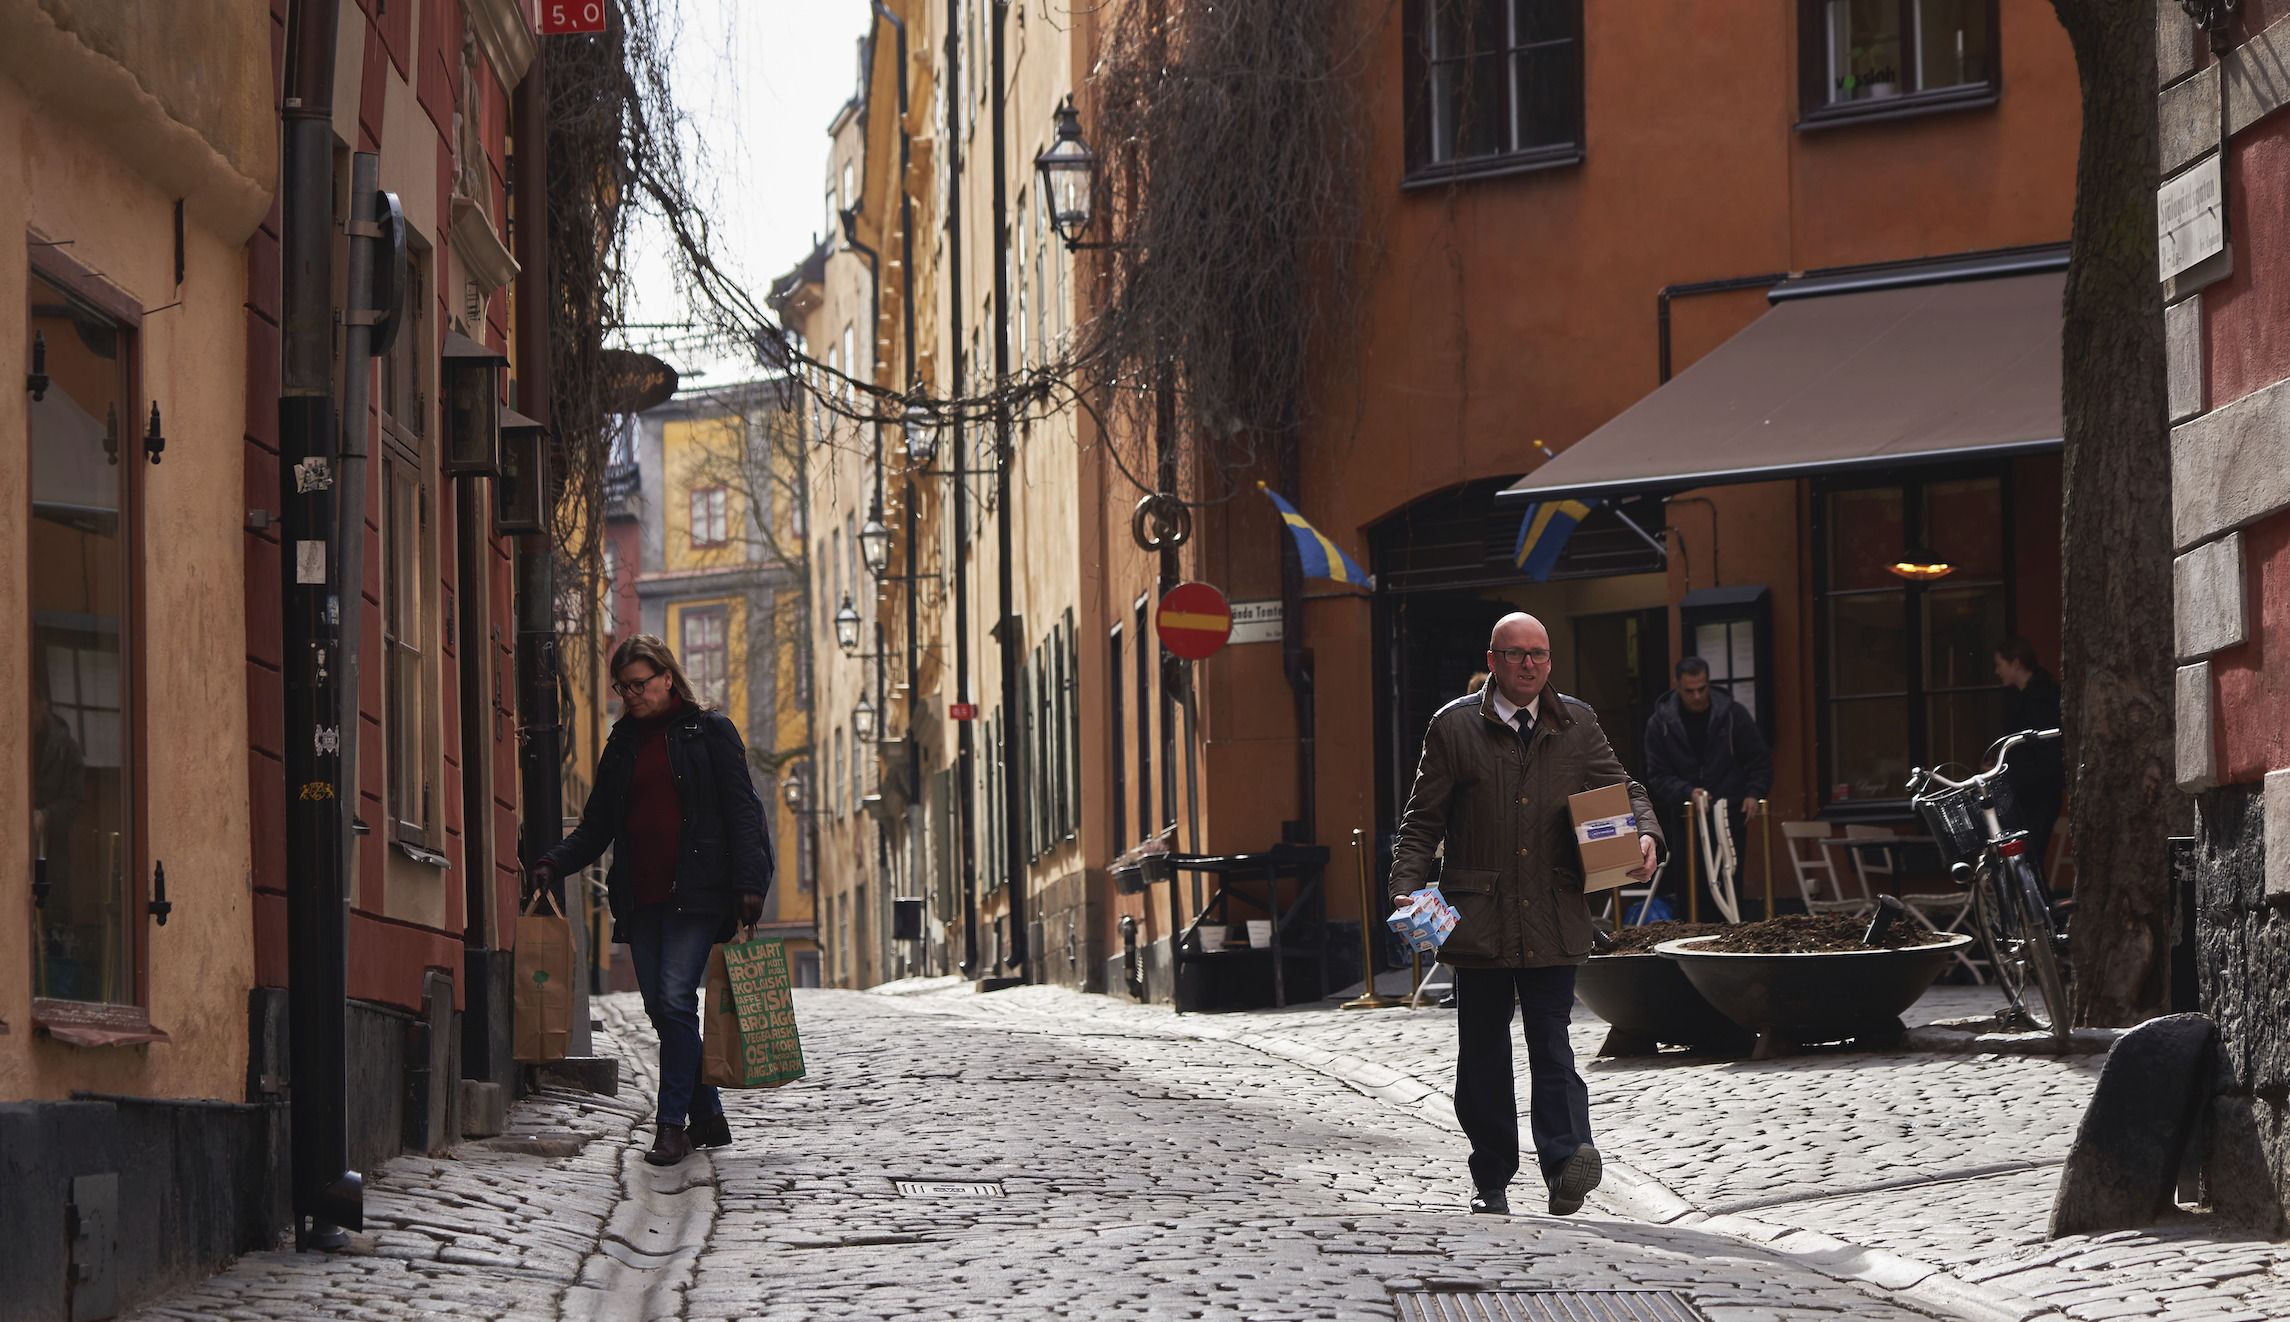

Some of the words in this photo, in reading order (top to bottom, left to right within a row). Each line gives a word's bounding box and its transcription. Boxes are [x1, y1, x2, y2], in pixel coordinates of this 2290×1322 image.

[553, 3, 599, 28] 5,0
[2160, 179, 2214, 231] Själagårdsgatan
[1231, 607, 1253, 620] ända
[1256, 606, 1283, 618] Tomte
[738, 1002, 763, 1016] JUICE
[761, 988, 792, 1011] ISK
